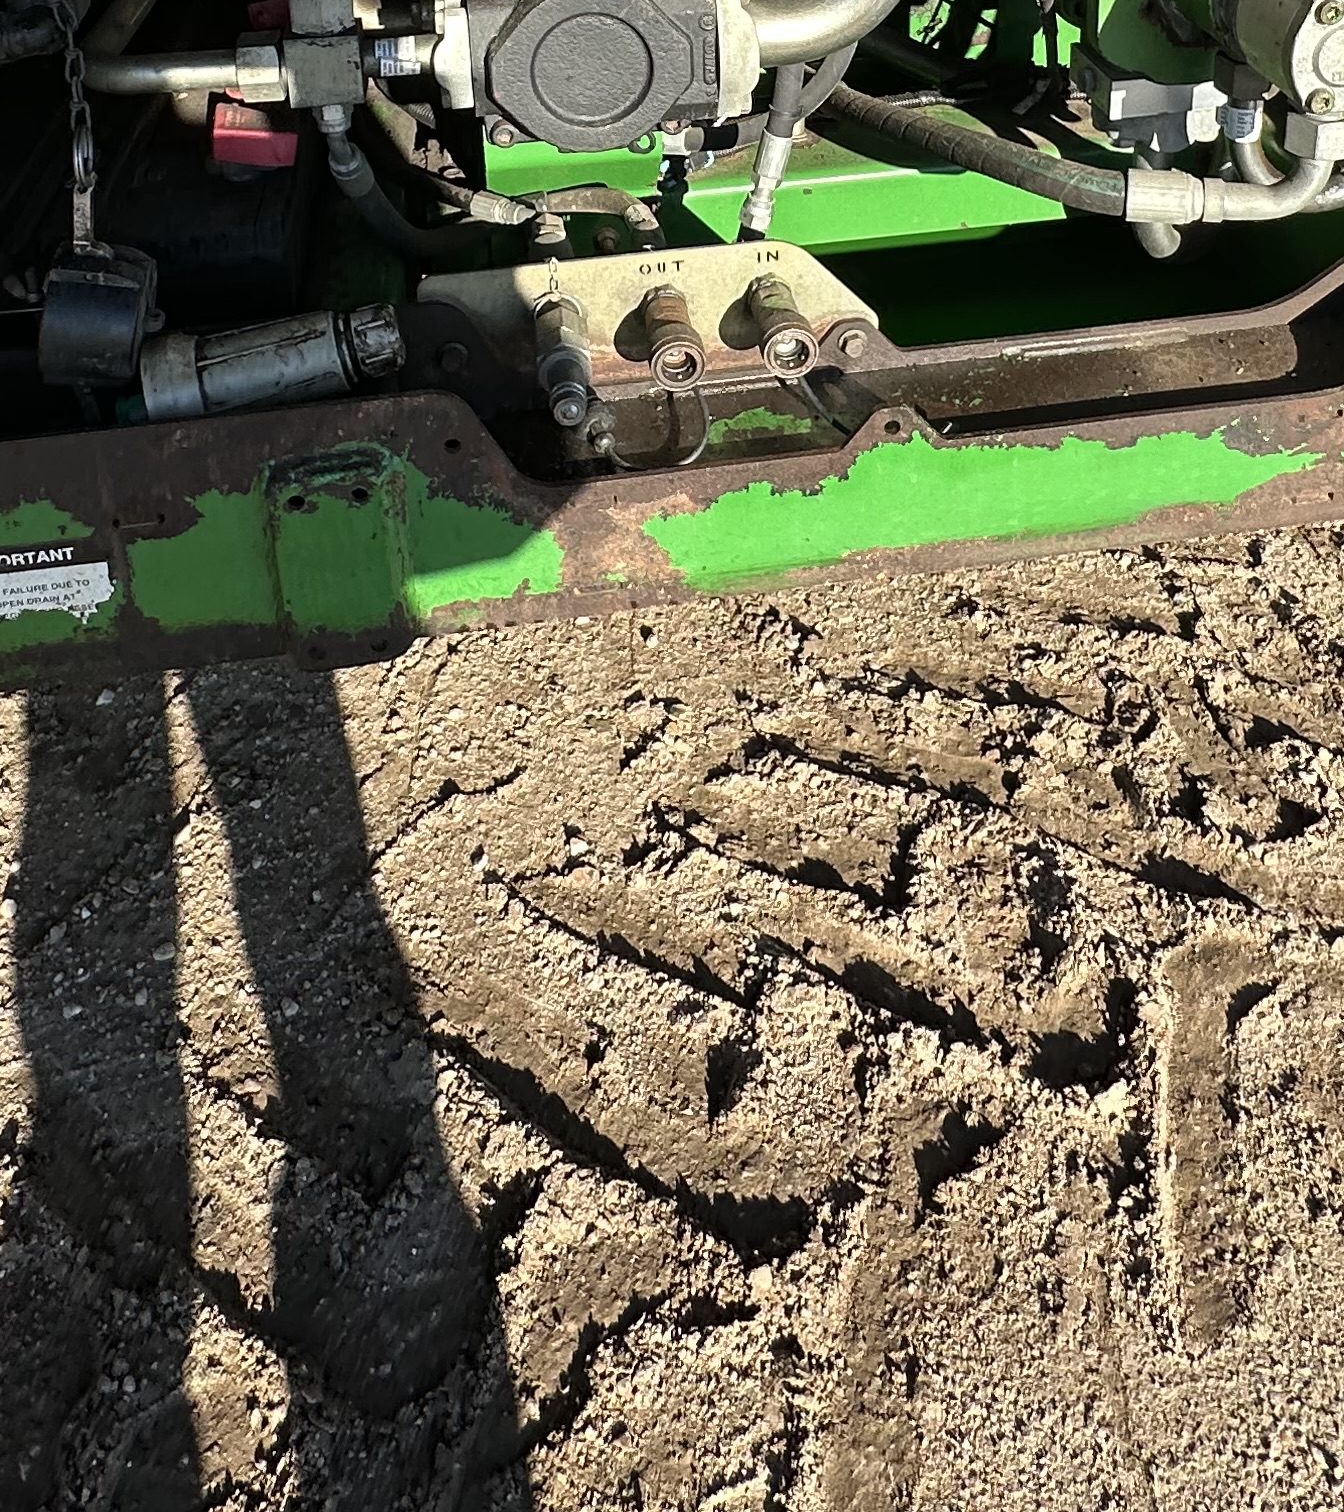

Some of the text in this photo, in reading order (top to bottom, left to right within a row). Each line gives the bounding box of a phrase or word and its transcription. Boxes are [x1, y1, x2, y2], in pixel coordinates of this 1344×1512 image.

[757, 249, 780, 264] IN
[639, 259, 685, 276] OUT
[2, 583, 49, 597] FAILURE
[50, 579, 74, 592] DUE
[76, 578, 91, 588] TO
[26, 594, 61, 607] DRAIN
[62, 592, 77, 603] AT
